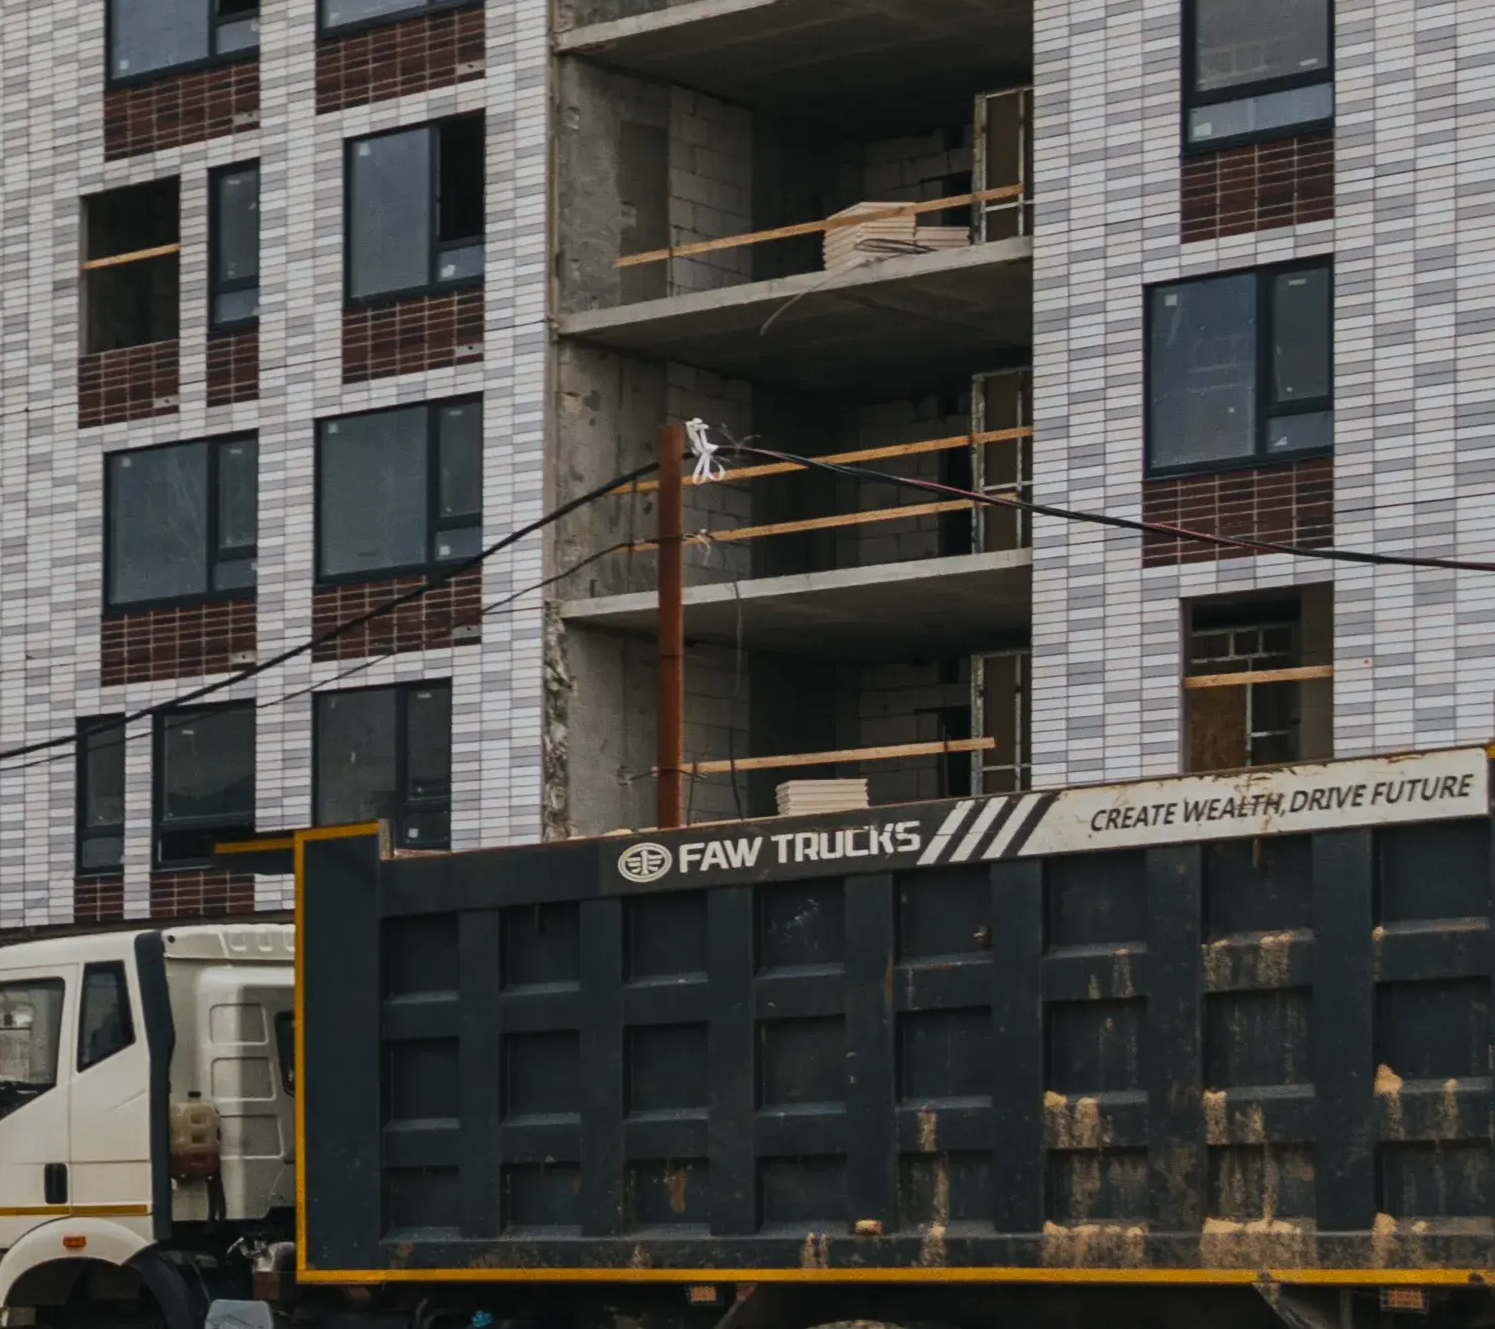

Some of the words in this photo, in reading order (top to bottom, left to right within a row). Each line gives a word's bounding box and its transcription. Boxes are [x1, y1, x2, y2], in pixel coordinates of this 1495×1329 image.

[1089, 802, 1176, 832] CREATE
[1370, 774, 1474, 805] FUTURE
[679, 836, 763, 874] FAW
[771, 820, 921, 864] TRUCKS
